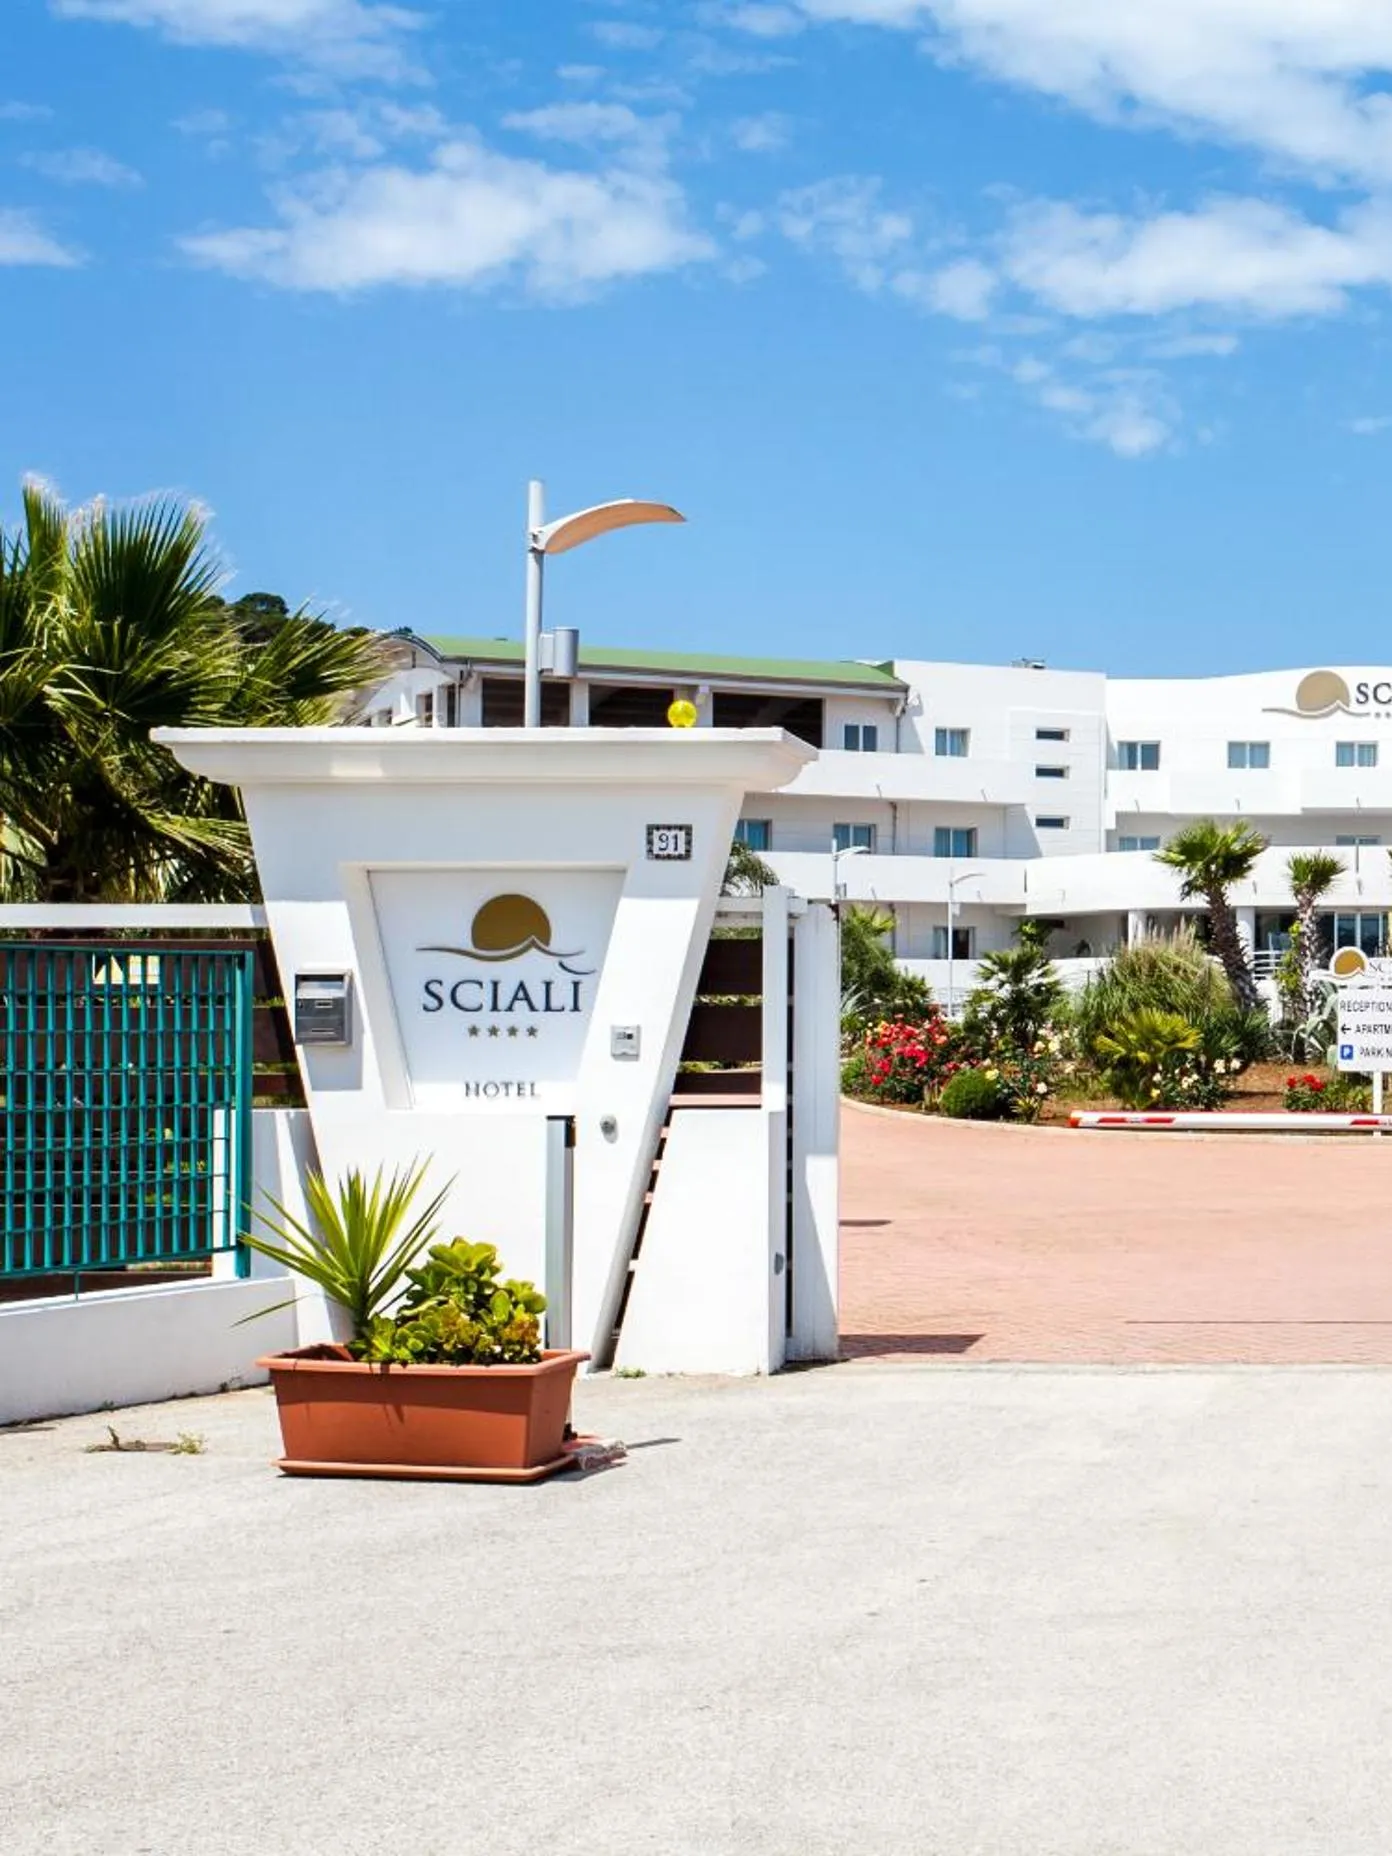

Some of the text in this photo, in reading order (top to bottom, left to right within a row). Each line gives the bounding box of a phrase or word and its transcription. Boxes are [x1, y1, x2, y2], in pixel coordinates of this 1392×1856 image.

[658, 833, 678, 851] 91
[1340, 1000, 1392, 1012] RECEPTION
[464, 1080, 541, 1098] HOTEL
